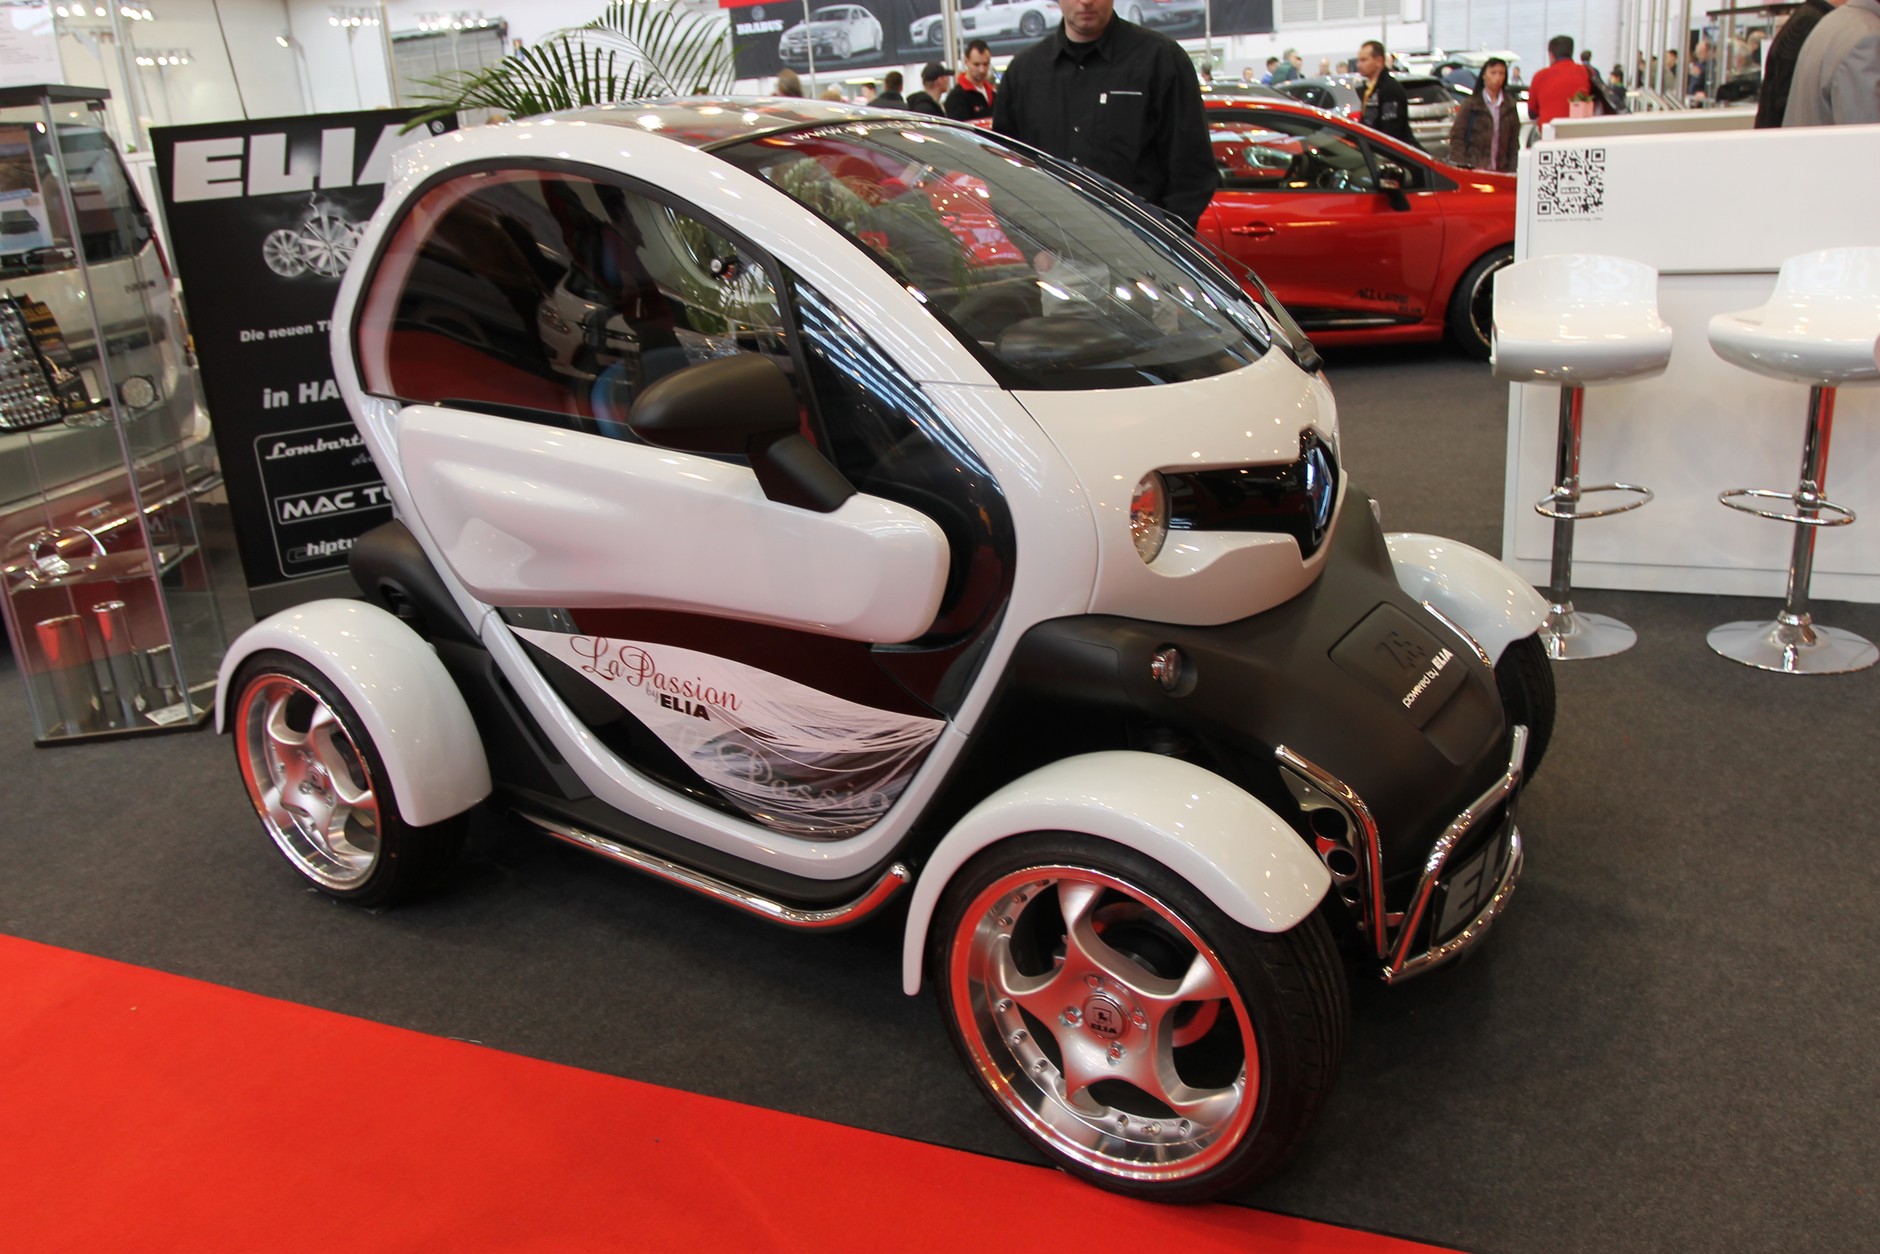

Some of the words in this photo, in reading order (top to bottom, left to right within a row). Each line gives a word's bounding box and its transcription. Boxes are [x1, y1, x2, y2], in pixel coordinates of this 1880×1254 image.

[736, 19, 784, 36] BRABUS
[240, 329, 265, 342] Die
[268, 324, 314, 339] neuen
[263, 388, 289, 409] in
[298, 379, 340, 404] HA
[282, 491, 356, 520] MAC
[1430, 647, 1454, 671] ELIA
[569, 636, 625, 681] La
[619, 645, 743, 711] Passion
[1425, 667, 1440, 680] by
[646, 681, 660, 704] by
[659, 693, 711, 721] ELIA
[1402, 674, 1431, 709] powered
[1091, 1022, 1118, 1035] ELIA
